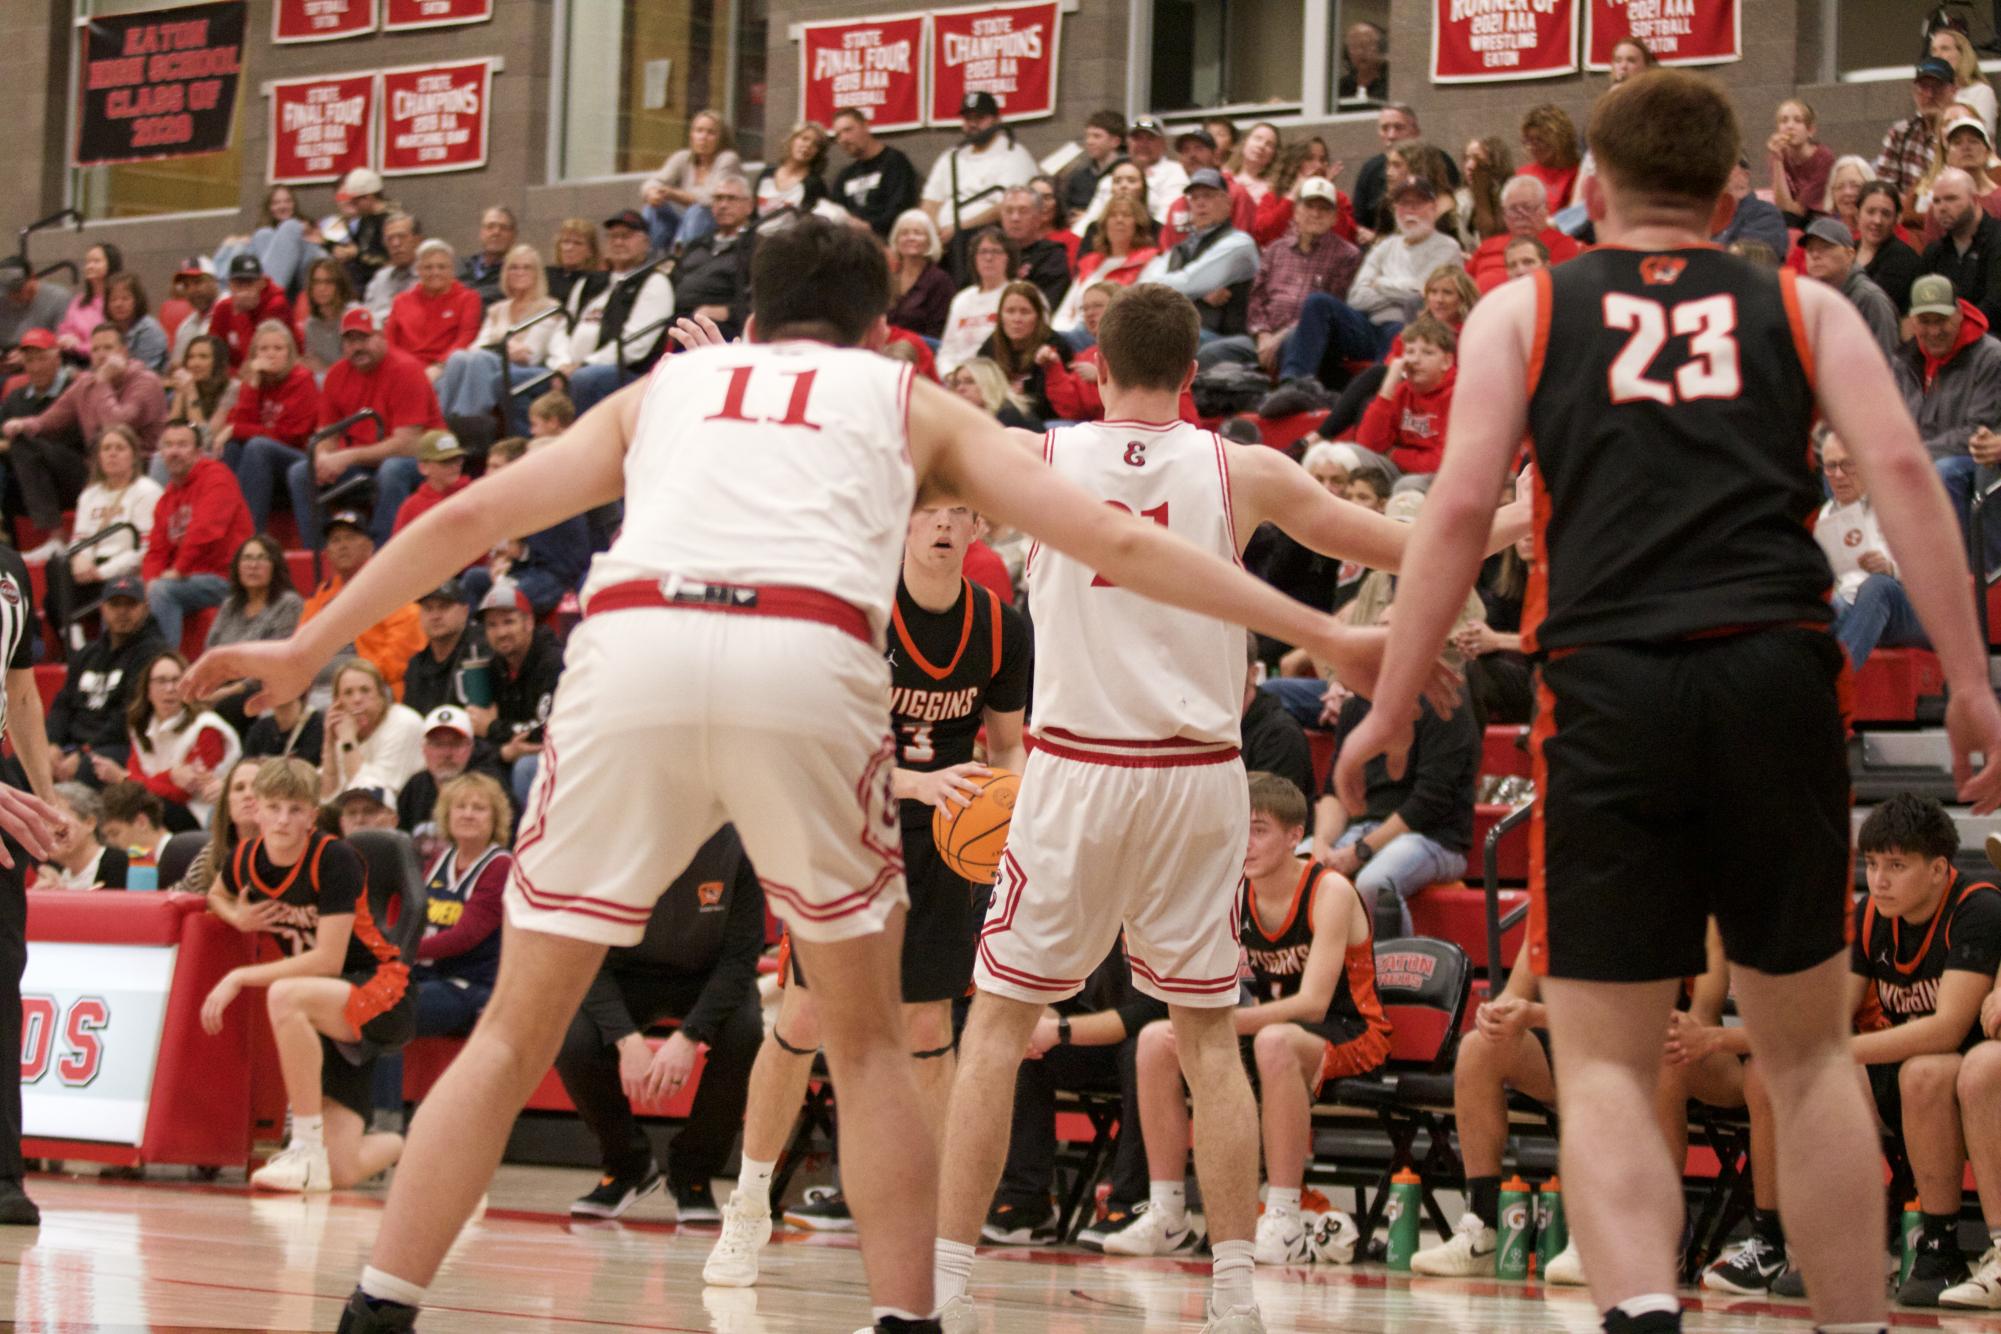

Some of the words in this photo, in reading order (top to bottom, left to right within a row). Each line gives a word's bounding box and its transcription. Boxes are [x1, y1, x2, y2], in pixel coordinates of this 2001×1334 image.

[1507, 12, 1536, 31] AAA
[1631, 18, 1692, 36] SOFTBALL
[815, 48, 861, 80] FINAL
[865, 41, 910, 73] FOUR
[944, 24, 1042, 66] CHAMPIONS
[1470, 33, 1536, 51] WRESTLING
[1602, 291, 1743, 406] 23
[703, 364, 822, 432] 11
[902, 721, 936, 763] 3
[1879, 976, 1940, 1014] WIGGIN
